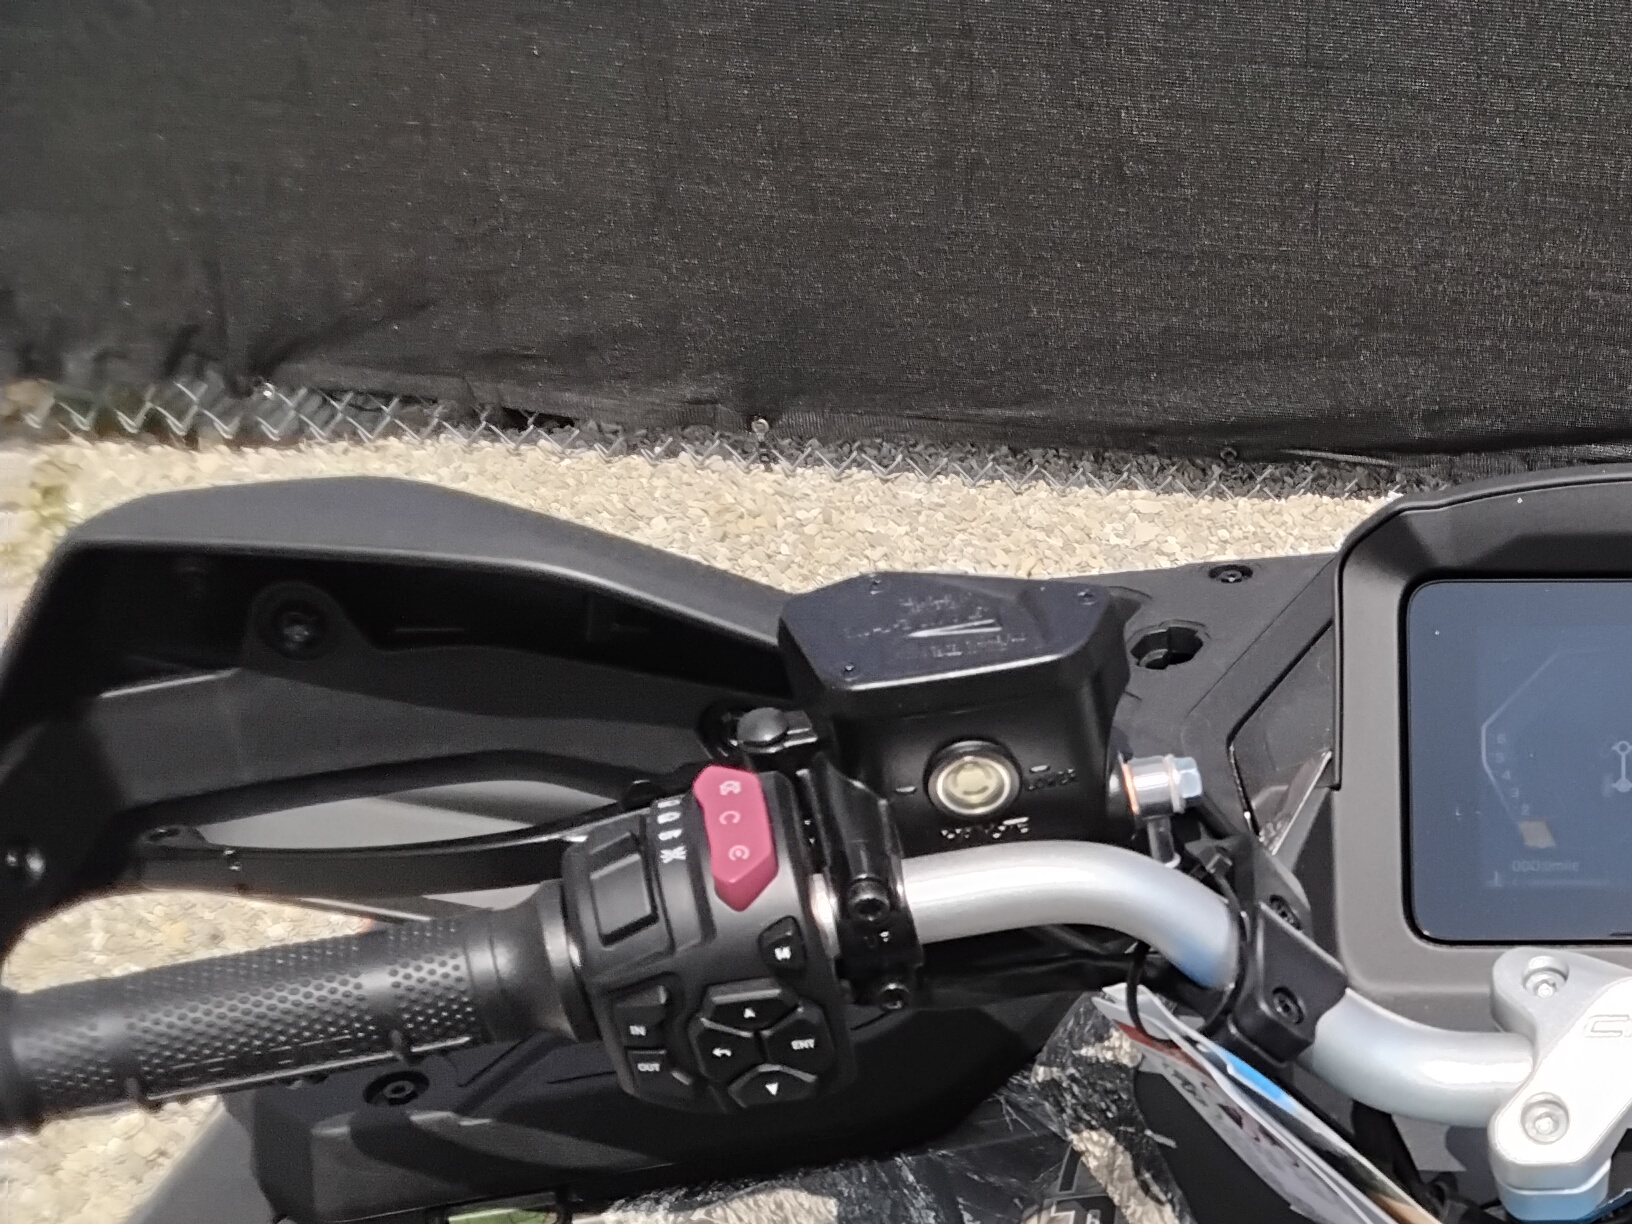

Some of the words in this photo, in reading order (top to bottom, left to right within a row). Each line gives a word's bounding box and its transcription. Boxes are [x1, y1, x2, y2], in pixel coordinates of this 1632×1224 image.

[774, 946, 791, 960] M
[629, 1025, 646, 1037] IN
[791, 1038, 815, 1050] ENT
[637, 1062, 661, 1072] OUT
